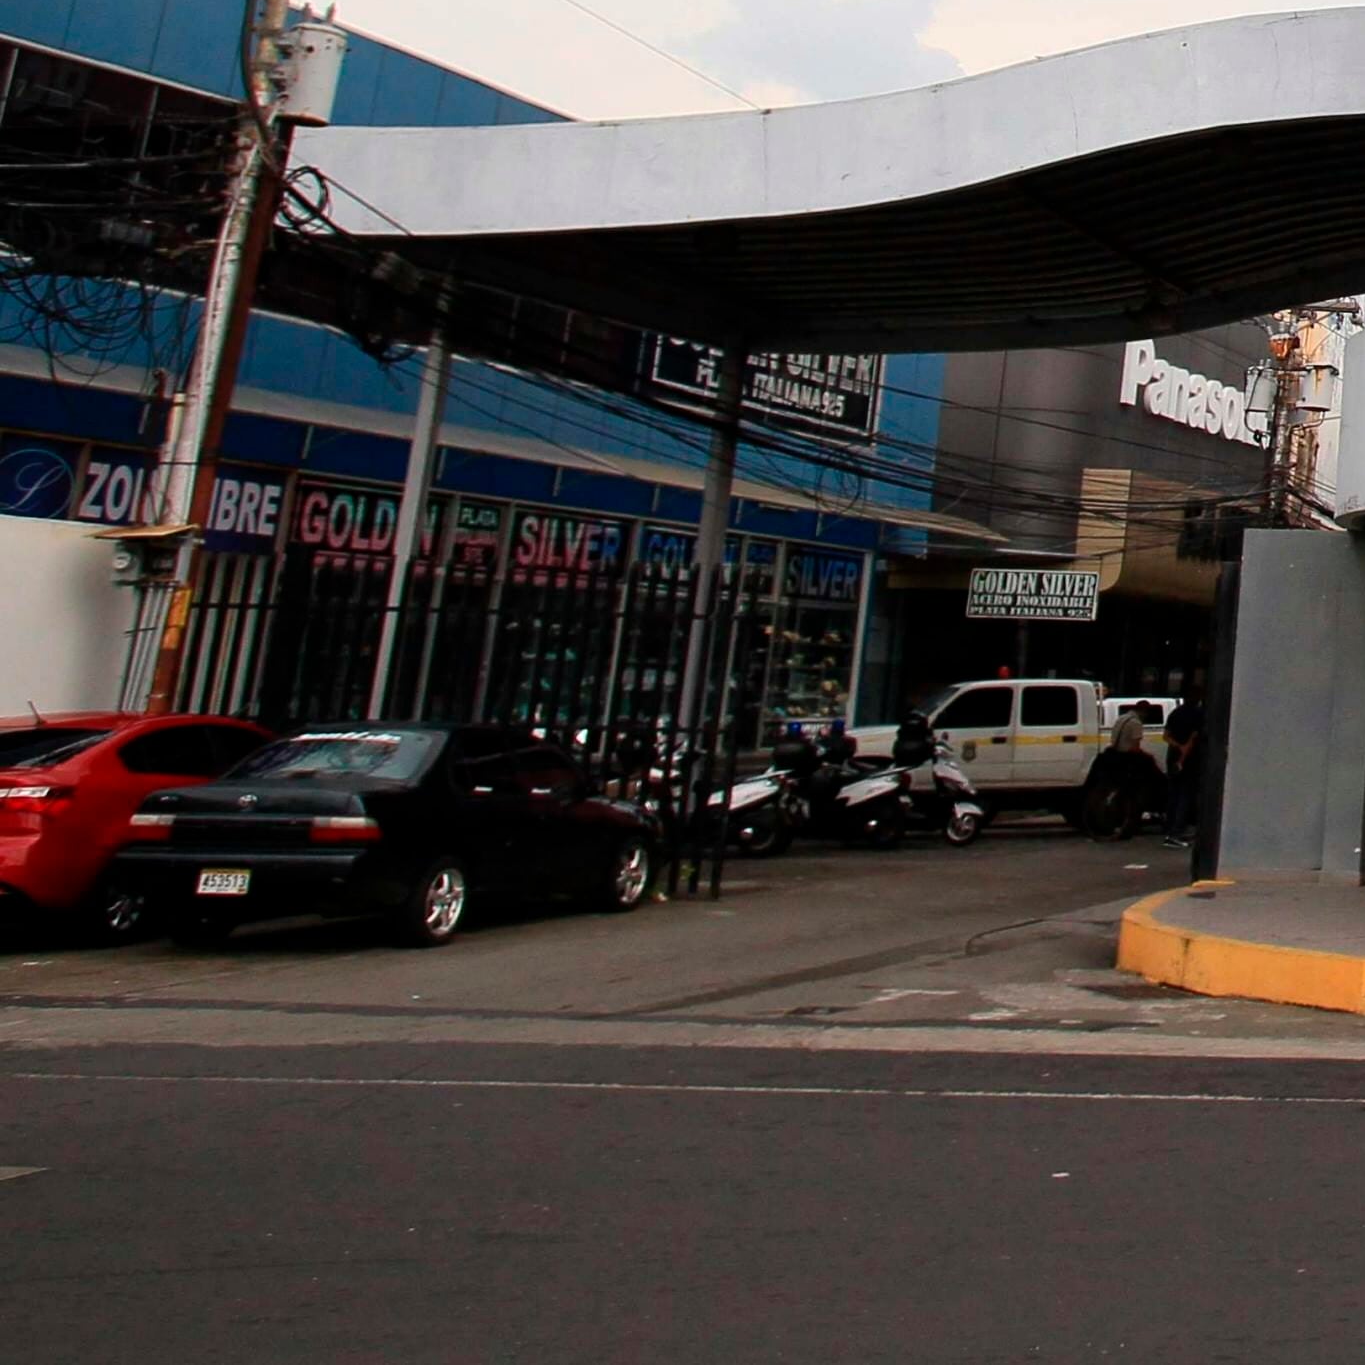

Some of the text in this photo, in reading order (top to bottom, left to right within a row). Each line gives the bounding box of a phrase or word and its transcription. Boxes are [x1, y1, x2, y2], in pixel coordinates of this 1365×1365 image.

[1120, 338, 1271, 450] Panaso
[77, 461, 283, 537] ZON IBRE
[516, 514, 622, 572] SILVER
[786, 551, 861, 601] SILVER
[971, 594, 1094, 608] ACERO INOXIDABLE
[972, 571, 1096, 597] GOLDEN SILVER
